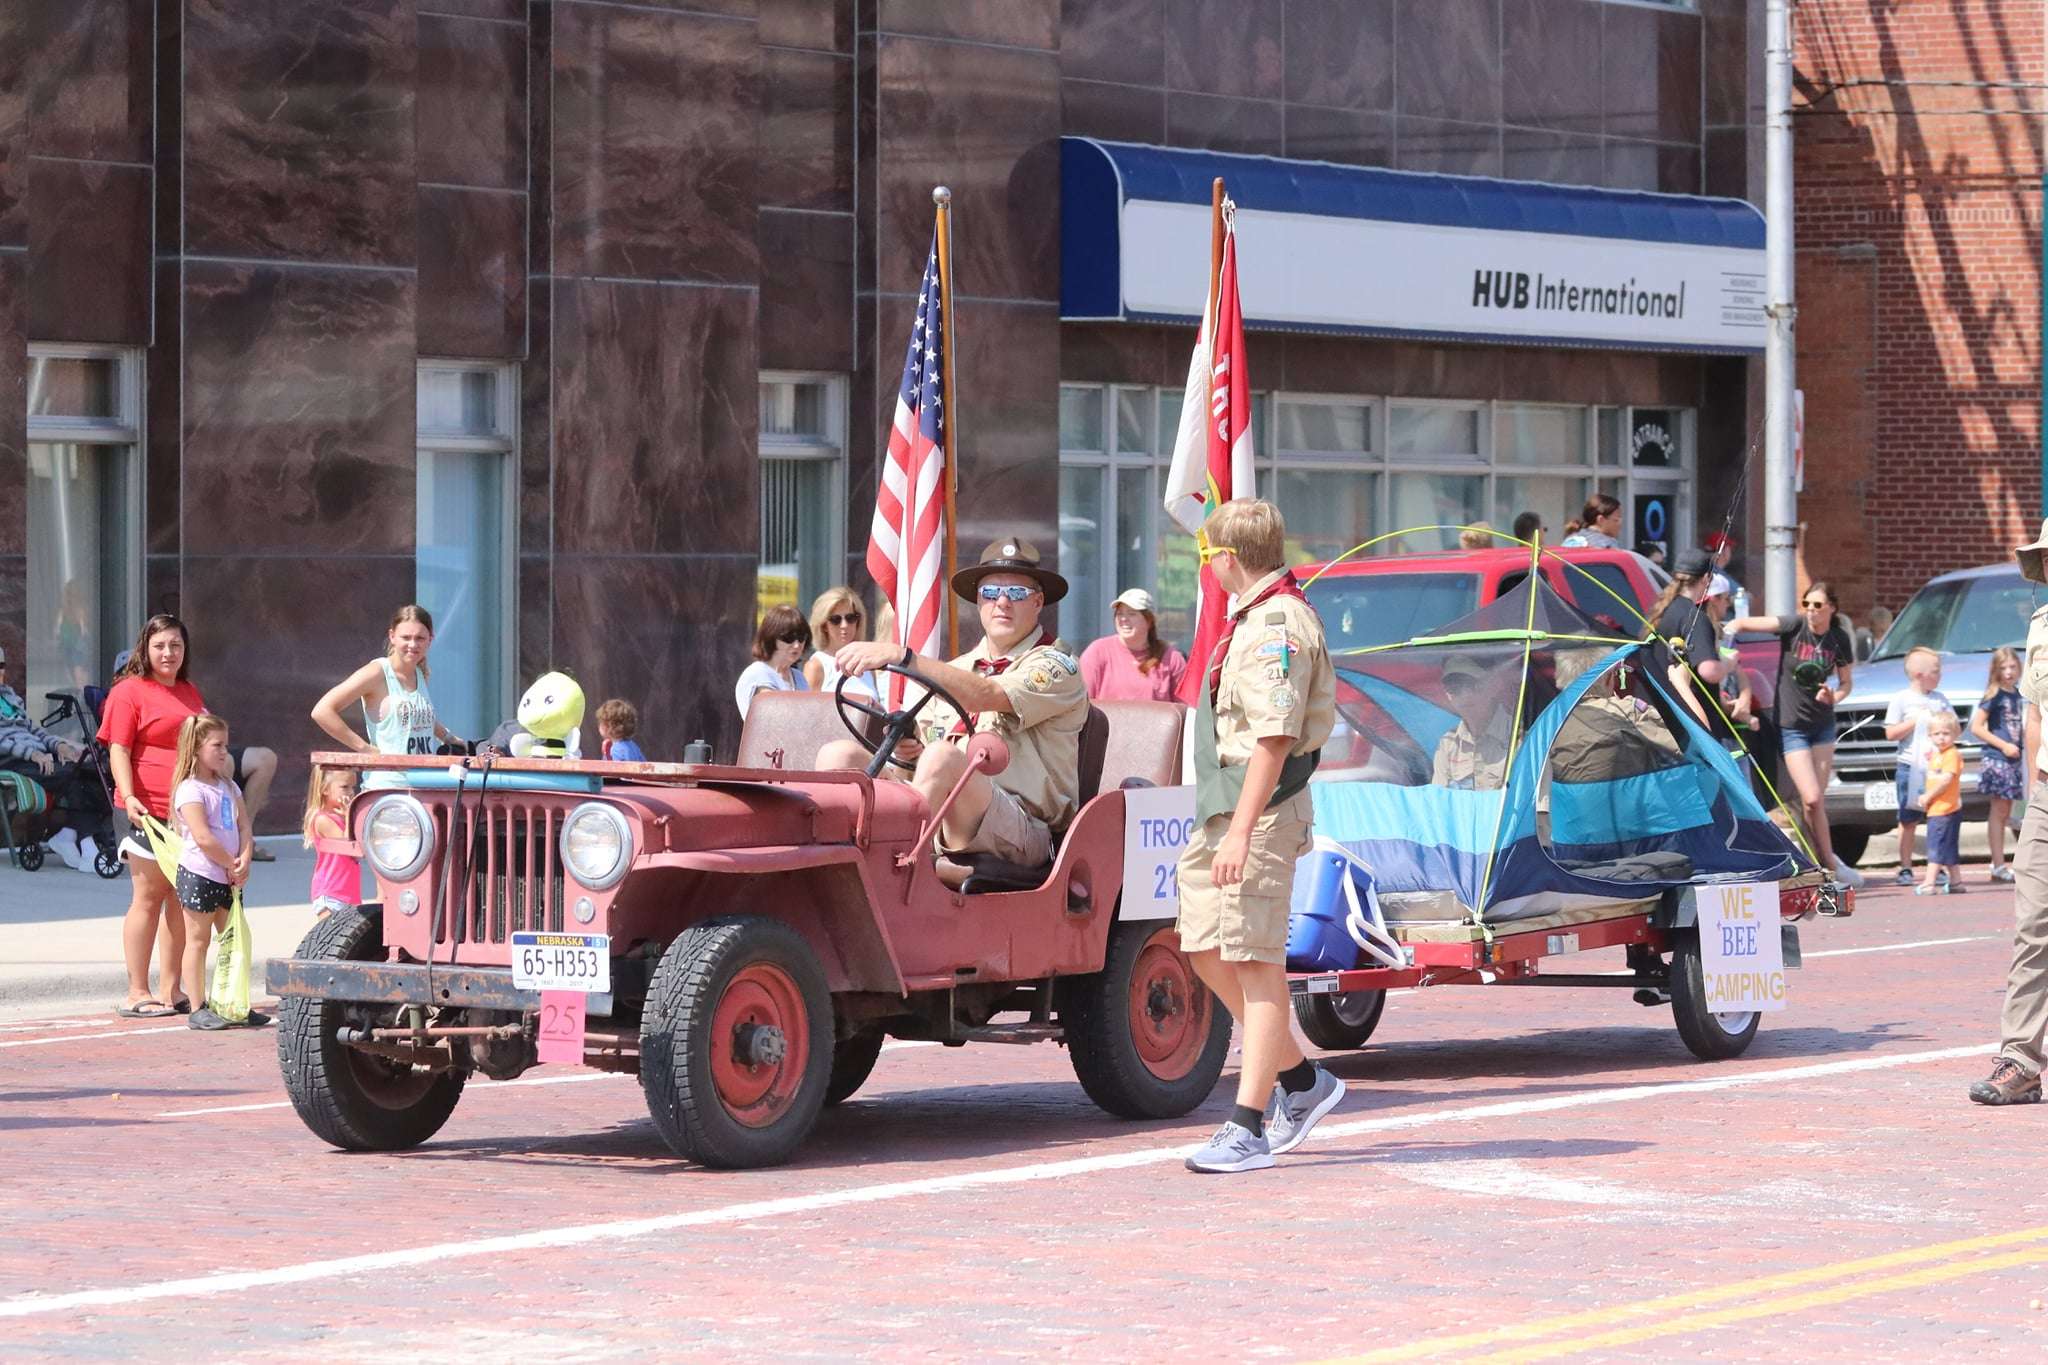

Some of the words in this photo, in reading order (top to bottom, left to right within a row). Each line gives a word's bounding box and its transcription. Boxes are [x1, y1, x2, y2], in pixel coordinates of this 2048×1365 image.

[1472, 269, 1529, 309] HUB
[1536, 272, 1685, 319] International
[1721, 887, 1754, 919] WE
[536, 935, 585, 946] NEBRASKA
[523, 949, 599, 978] 65-H353
[1705, 972, 1785, 1002] CAMPING
[542, 1004, 577, 1036] 25
